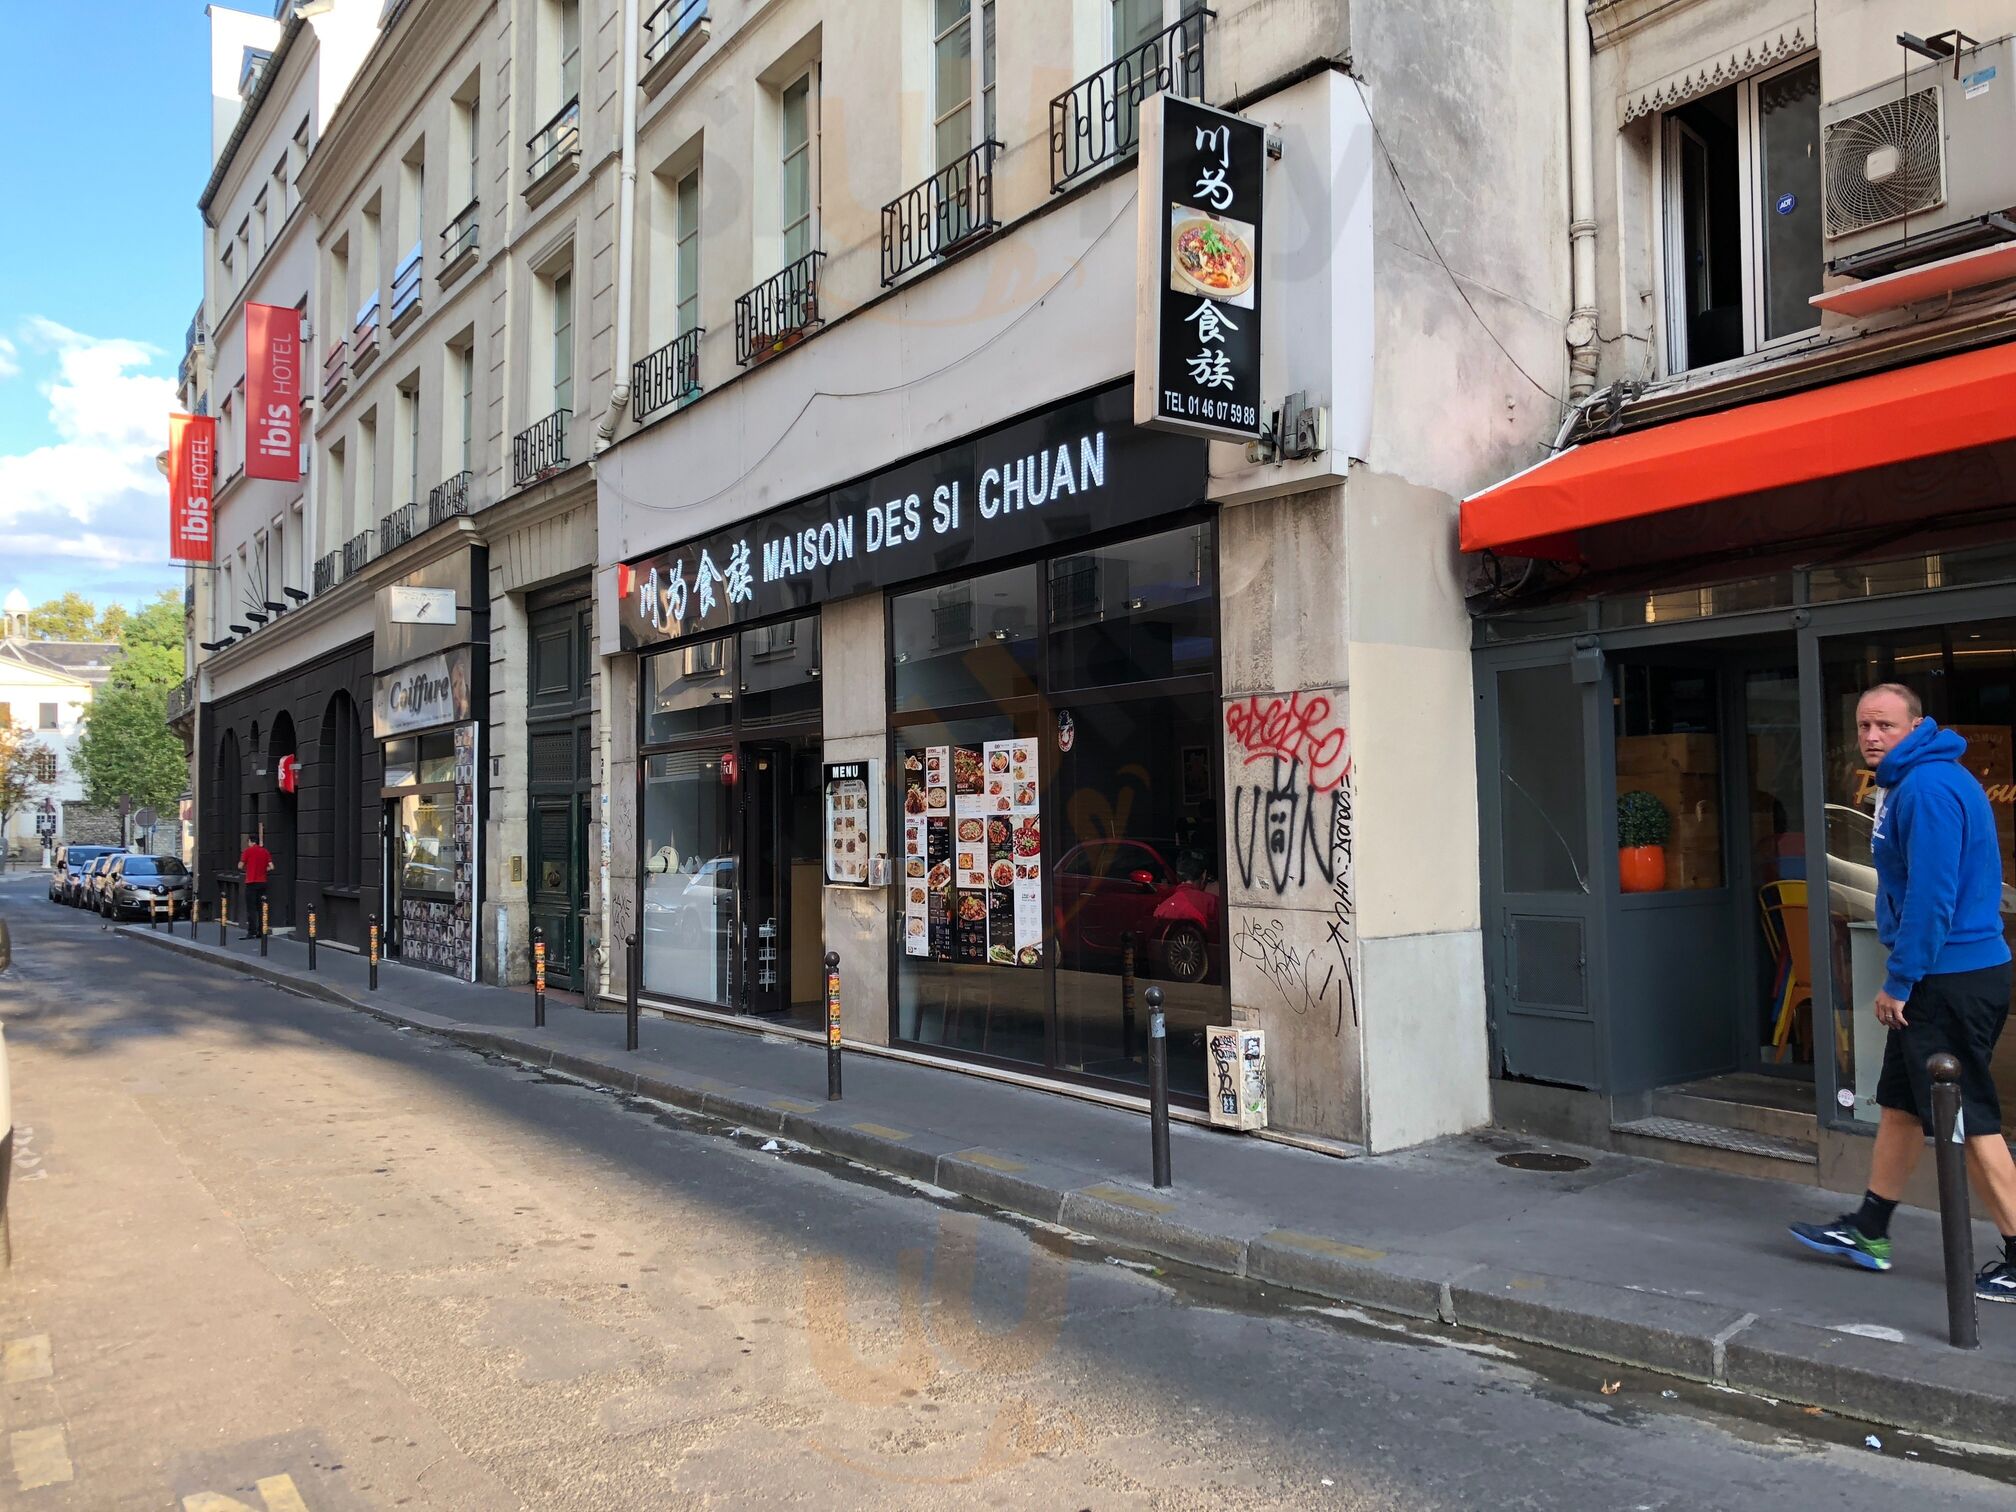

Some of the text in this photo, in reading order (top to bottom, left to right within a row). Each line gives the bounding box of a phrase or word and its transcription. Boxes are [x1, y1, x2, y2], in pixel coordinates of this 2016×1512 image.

[1779, 198, 1792, 210] ADT
[1184, 298, 1239, 392] 食族
[260, 333, 292, 457] ibis HOTEL
[1164, 390, 1255, 426] TEL 01 46 07 59 88
[180, 436, 208, 542] ibis HOTEL
[763, 431, 1105, 583] MAISON DES SI CHUAN
[639, 539, 753, 629] 川为食族
[391, 673, 449, 714] Coiffure
[832, 765, 859, 779] MENU
